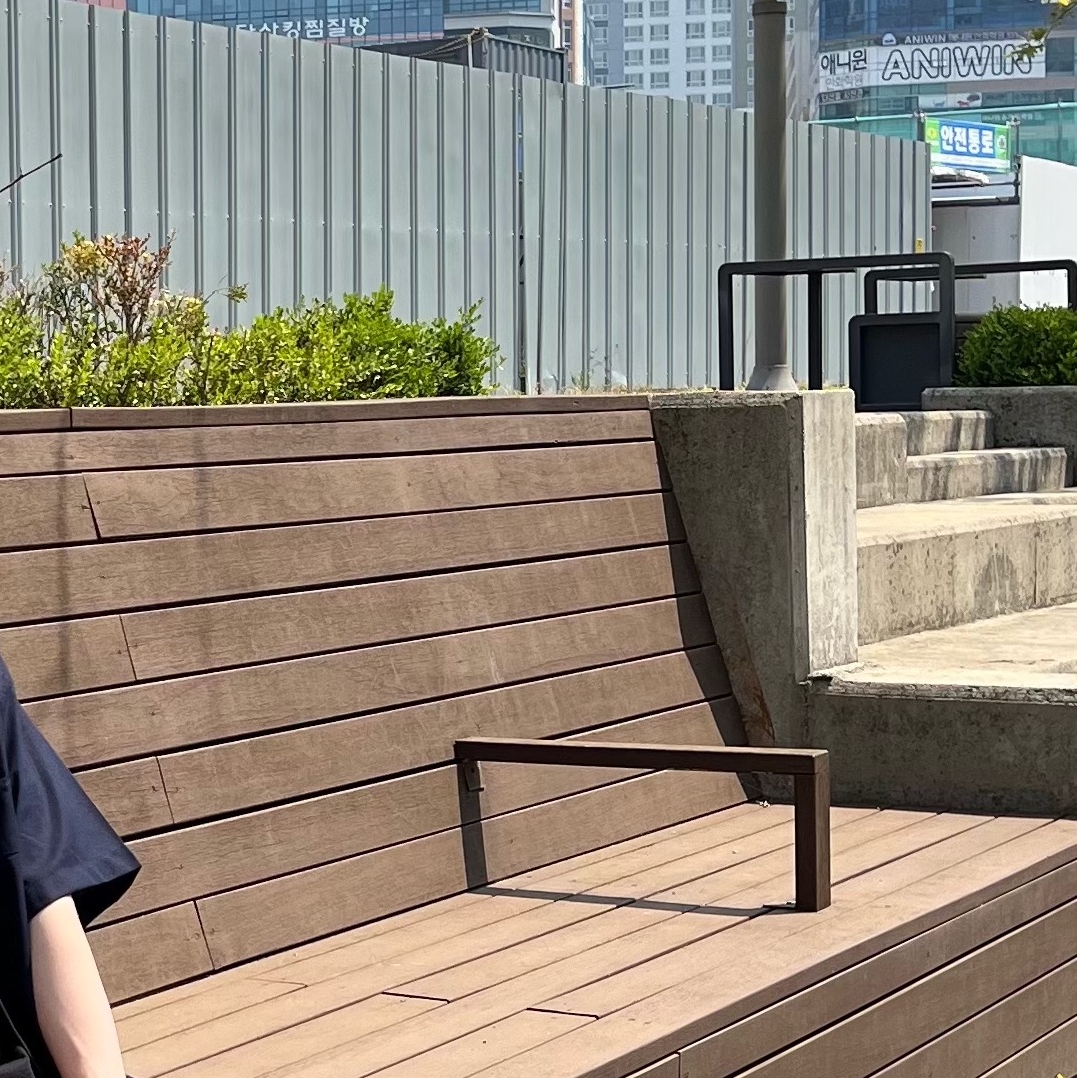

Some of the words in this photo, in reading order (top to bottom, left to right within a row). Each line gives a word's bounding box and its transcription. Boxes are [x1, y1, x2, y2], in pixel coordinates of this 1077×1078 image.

[904, 33, 947, 45] ANIWIN
[820, 48, 867, 76] 애니윈
[881, 43, 1032, 81] ANIWIN
[940, 125, 995, 155] 안전통로
